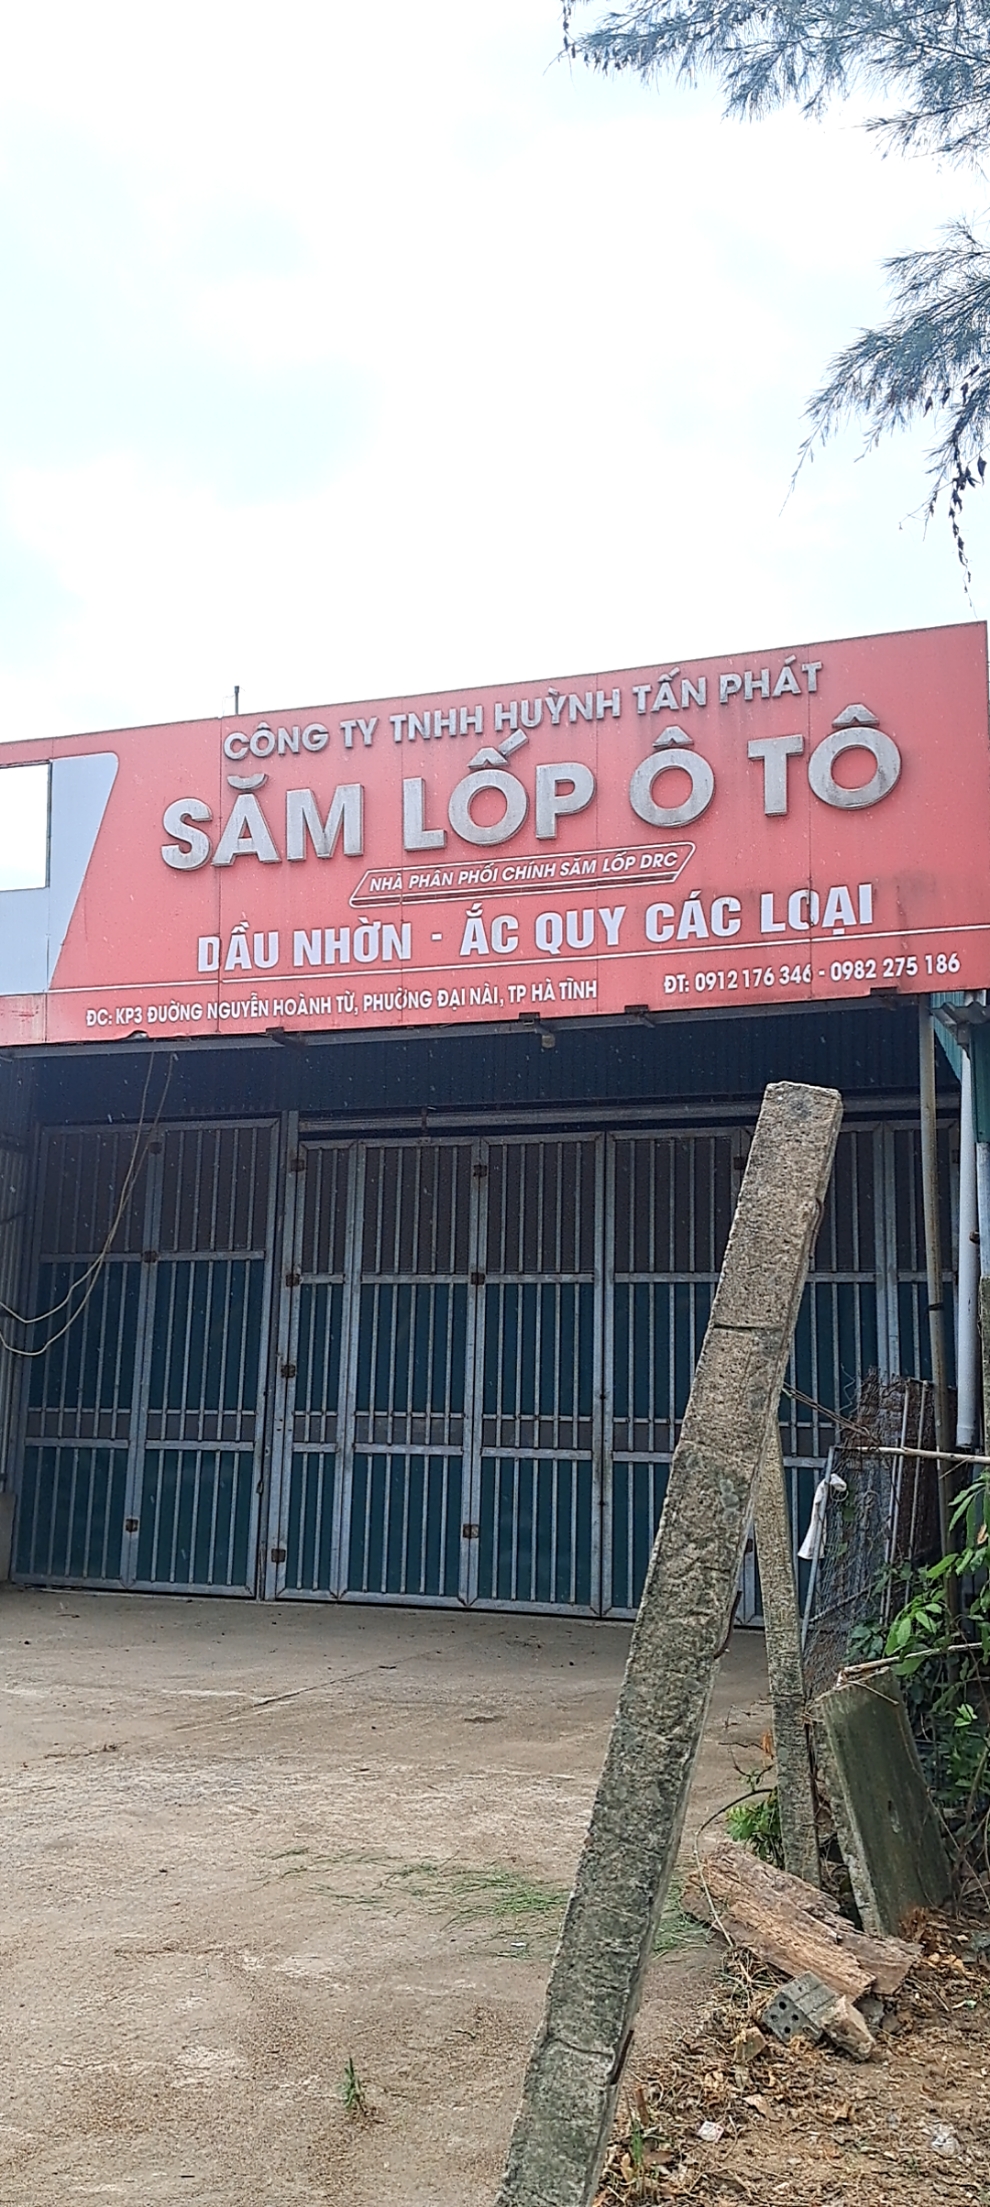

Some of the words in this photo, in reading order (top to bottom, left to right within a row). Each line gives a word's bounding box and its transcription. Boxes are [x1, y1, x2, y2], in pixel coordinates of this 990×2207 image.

[222, 721, 330, 760] CÔNG
[340, 717, 379, 749] TY
[390, 705, 484, 743] TNHH
[494, 686, 621, 731] HUỲNH
[632, 667, 707, 714] TẤN
[719, 654, 823, 703] PHÁT
[161, 773, 365, 871] SĂM
[402, 729, 596, 851] LỐP
[629, 725, 716, 829] Ô
[747, 703, 902, 816] TÔ
[369, 871, 403, 892] NHÀ
[408, 870, 453, 889] PHÂN
[457, 863, 498, 885] PHỐI
[501, 861, 556, 881] CHÍNH
[559, 857, 597, 877] SĂM
[602, 851, 635, 873] LỐP
[639, 851, 679, 869] DRC
[197, 921, 279, 972] DẦU
[293, 916, 412, 967] NHỜN
[459, 903, 519, 956] ẮC
[534, 906, 627, 955] QUY
[645, 890, 742, 943] CÁC
[760, 883, 873, 936] LOẠI
[86, 1008, 112, 1026] ĐC:
[116, 1007, 143, 1024] KP3
[207, 992, 269, 1020] NGUYỄN
[273, 993, 332, 1016] HOÀNH
[336, 990, 358, 1015] TỪ,
[437, 988, 465, 1011] ĐẠI
[508, 984, 527, 1003] TP
[531, 978, 556, 1002] HÀ
[664, 974, 689, 994] ĐT:
[695, 970, 738, 991] 0912
[743, 967, 775, 988] 176
[779, 964, 812, 985] 346
[830, 960, 877, 982] 0982
[883, 956, 917, 978] 275
[925, 953, 961, 975] 186
